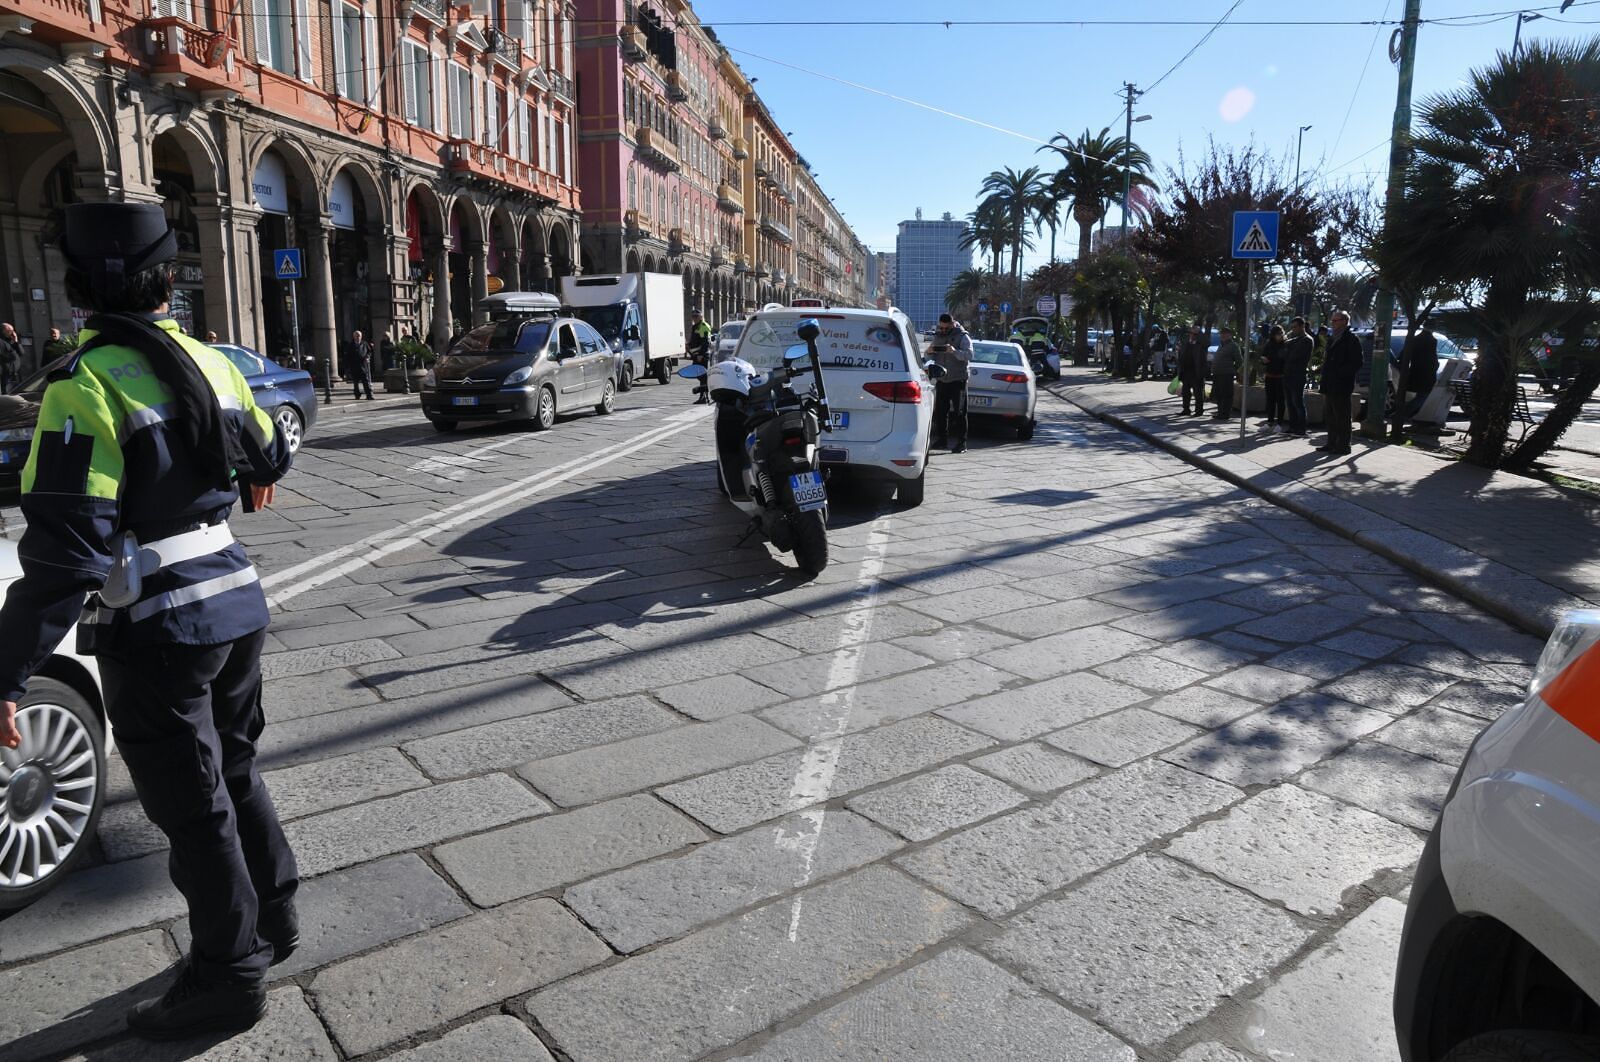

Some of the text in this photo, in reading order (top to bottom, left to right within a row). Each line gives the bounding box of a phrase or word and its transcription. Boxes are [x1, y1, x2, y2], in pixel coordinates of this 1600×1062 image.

[821, 329, 848, 339] Vieni
[843, 342, 880, 353] vedere
[834, 355, 894, 371] 070.276181
[795, 487, 824, 502] 00566
